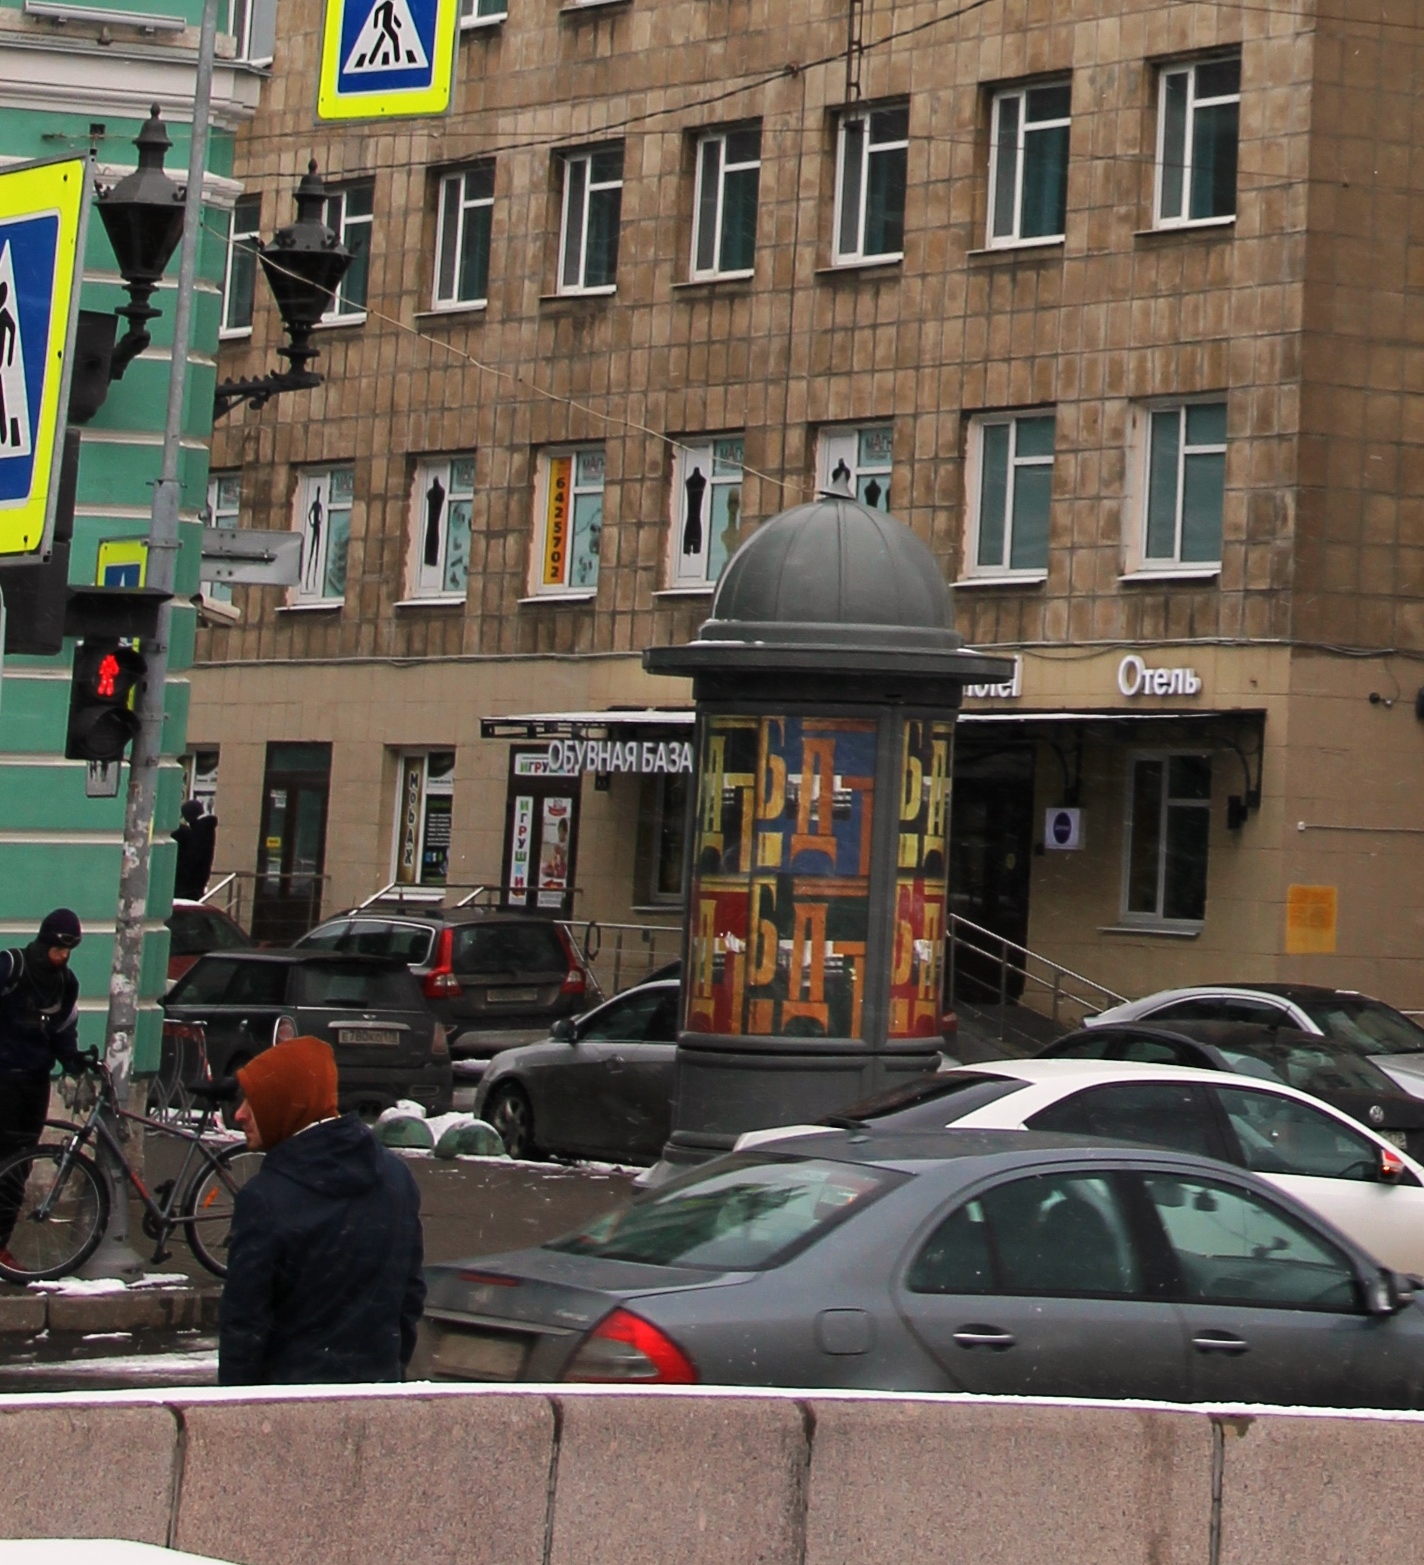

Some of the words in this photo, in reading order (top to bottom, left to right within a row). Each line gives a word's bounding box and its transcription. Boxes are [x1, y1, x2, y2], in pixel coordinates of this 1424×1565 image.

[551, 476, 566, 578] 6425702
[1118, 654, 1202, 697] Отель
[549, 739, 637, 773] ОБУВНАЯ
[642, 741, 694, 774] БАЗА
[514, 799, 530, 888] ИГРУШКИ
